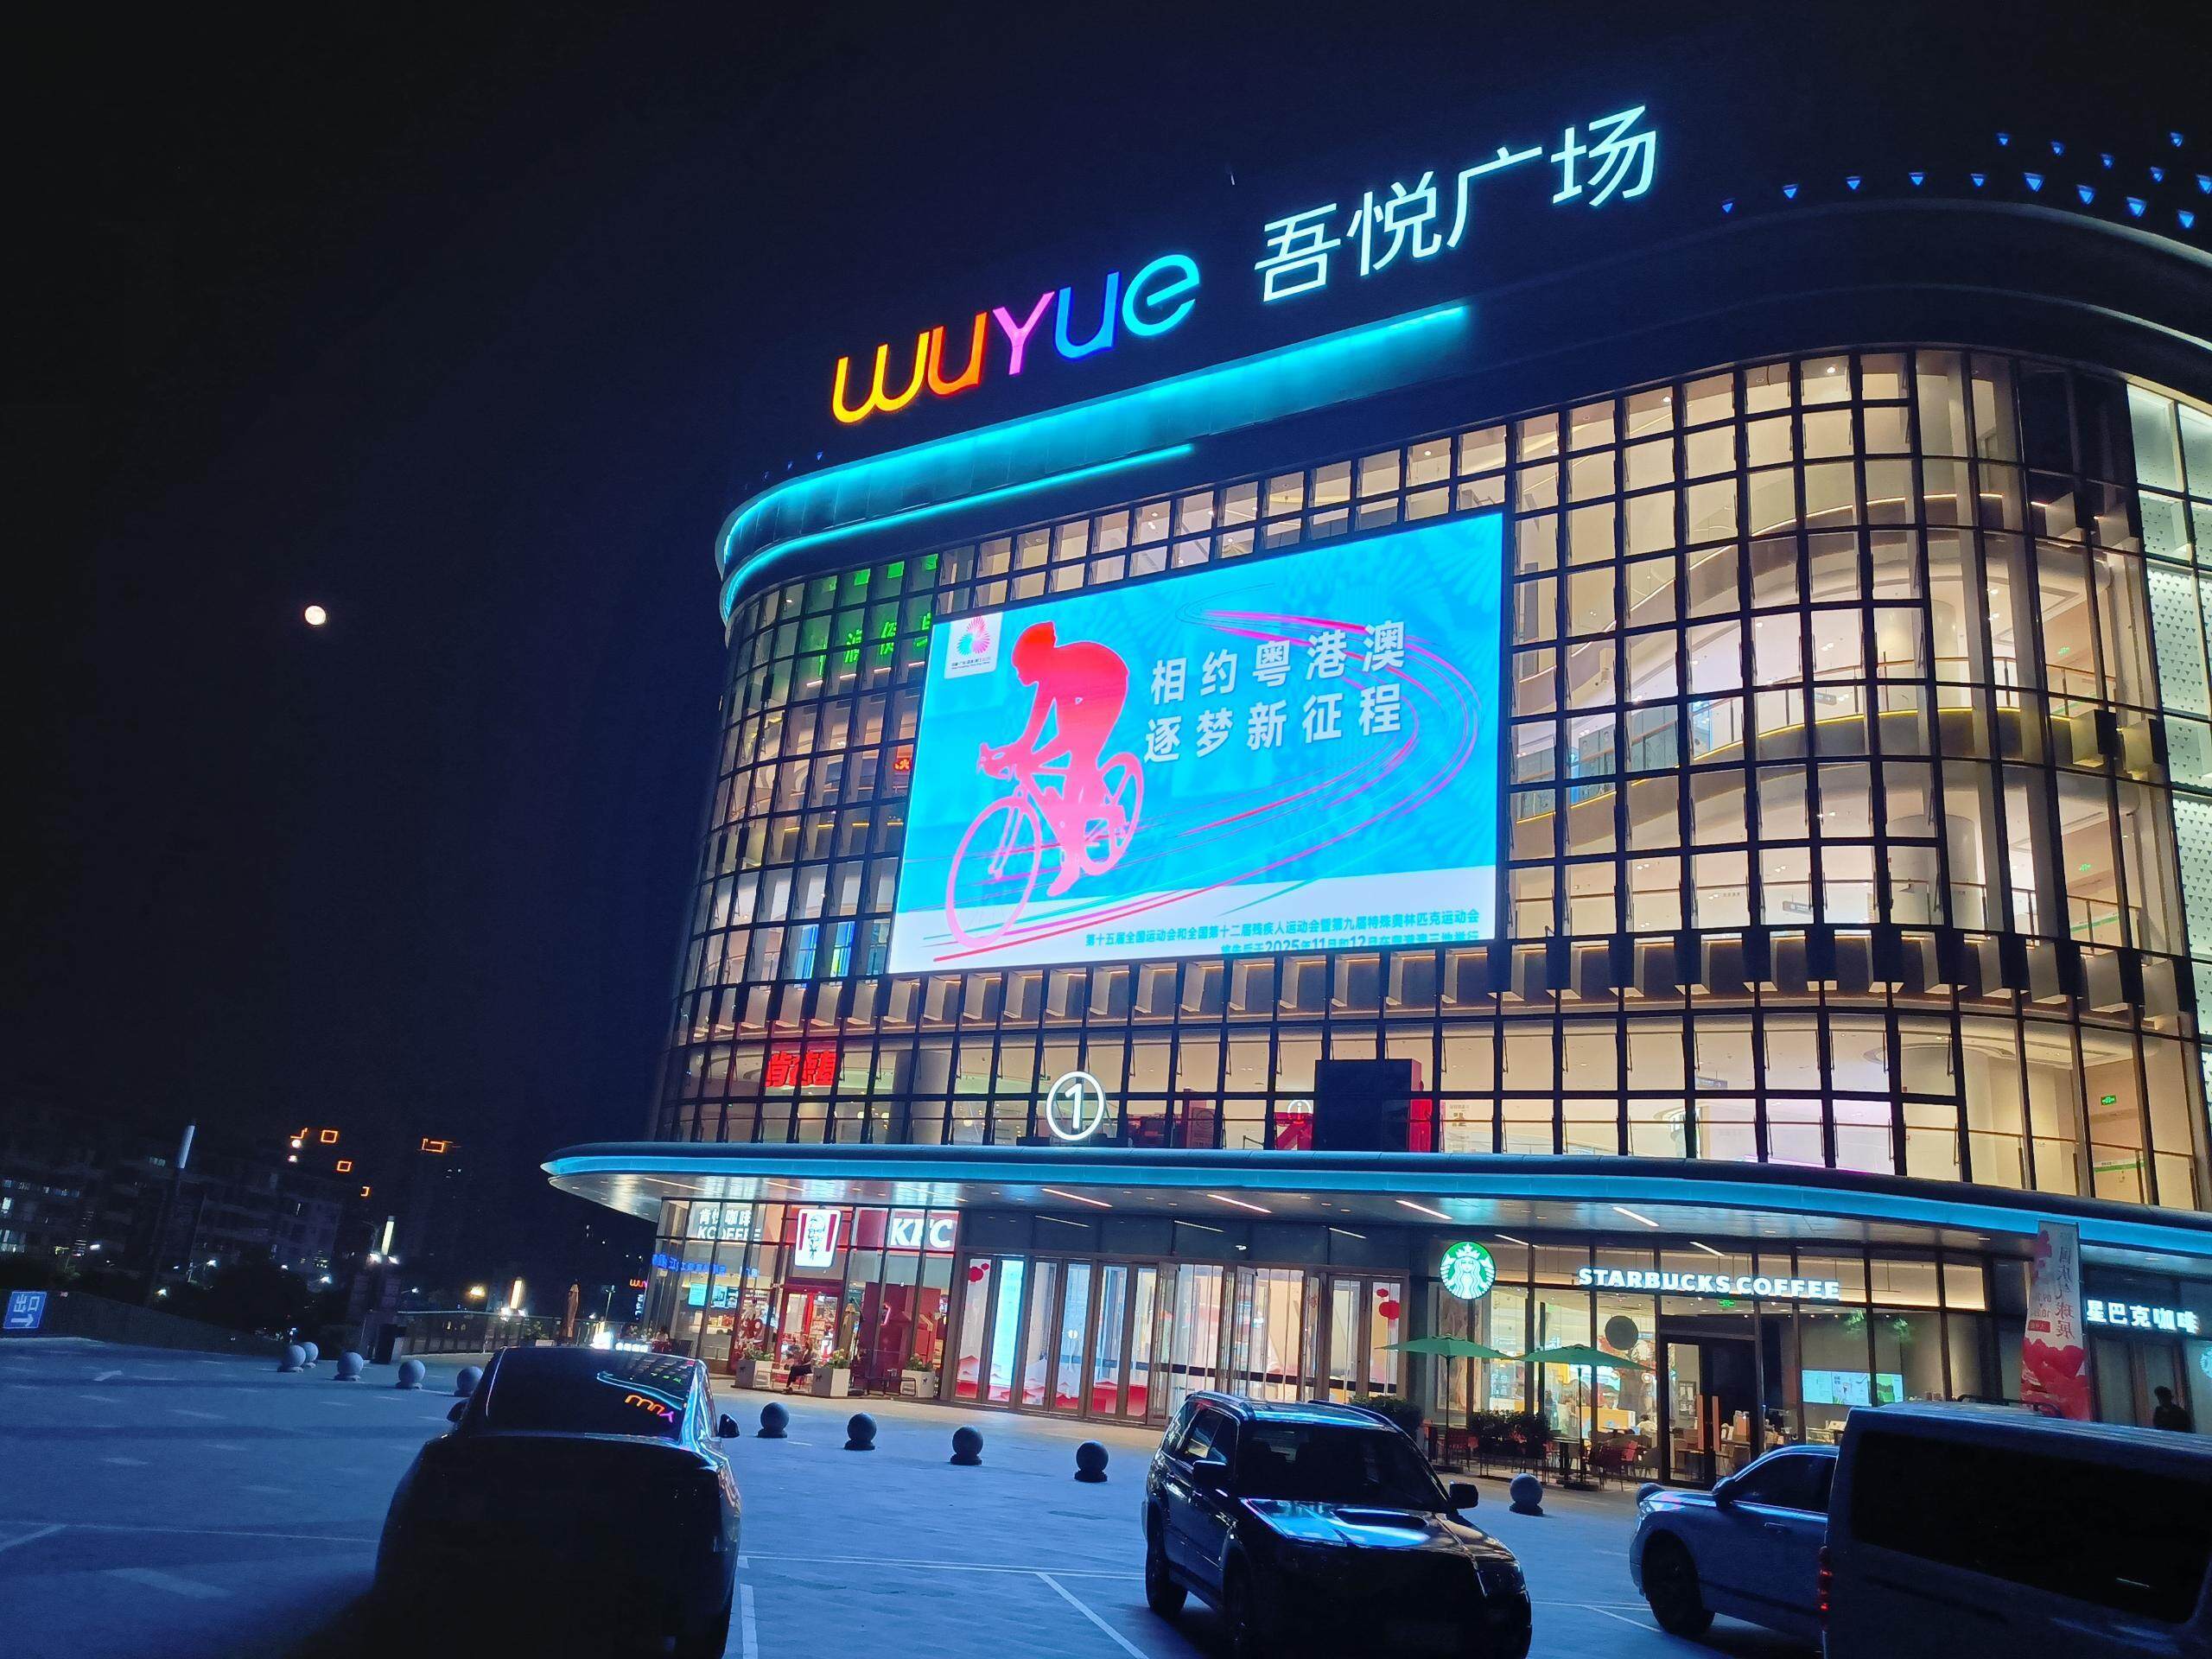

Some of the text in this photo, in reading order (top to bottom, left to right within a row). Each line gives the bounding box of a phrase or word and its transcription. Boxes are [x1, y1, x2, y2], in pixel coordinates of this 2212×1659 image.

[1254, 105, 1657, 302] 吾悦广场
[1150, 620, 1405, 704] 相约粤港澳
[1143, 683, 1402, 764] 逐梦新征程
[890, 1217, 953, 1249] KFC
[1579, 1267, 1840, 1300] STARBUCKS COFFEE
[14, 1294, 40, 1313] 出口
[2086, 1299, 2200, 1334] 星巴克咖啡
